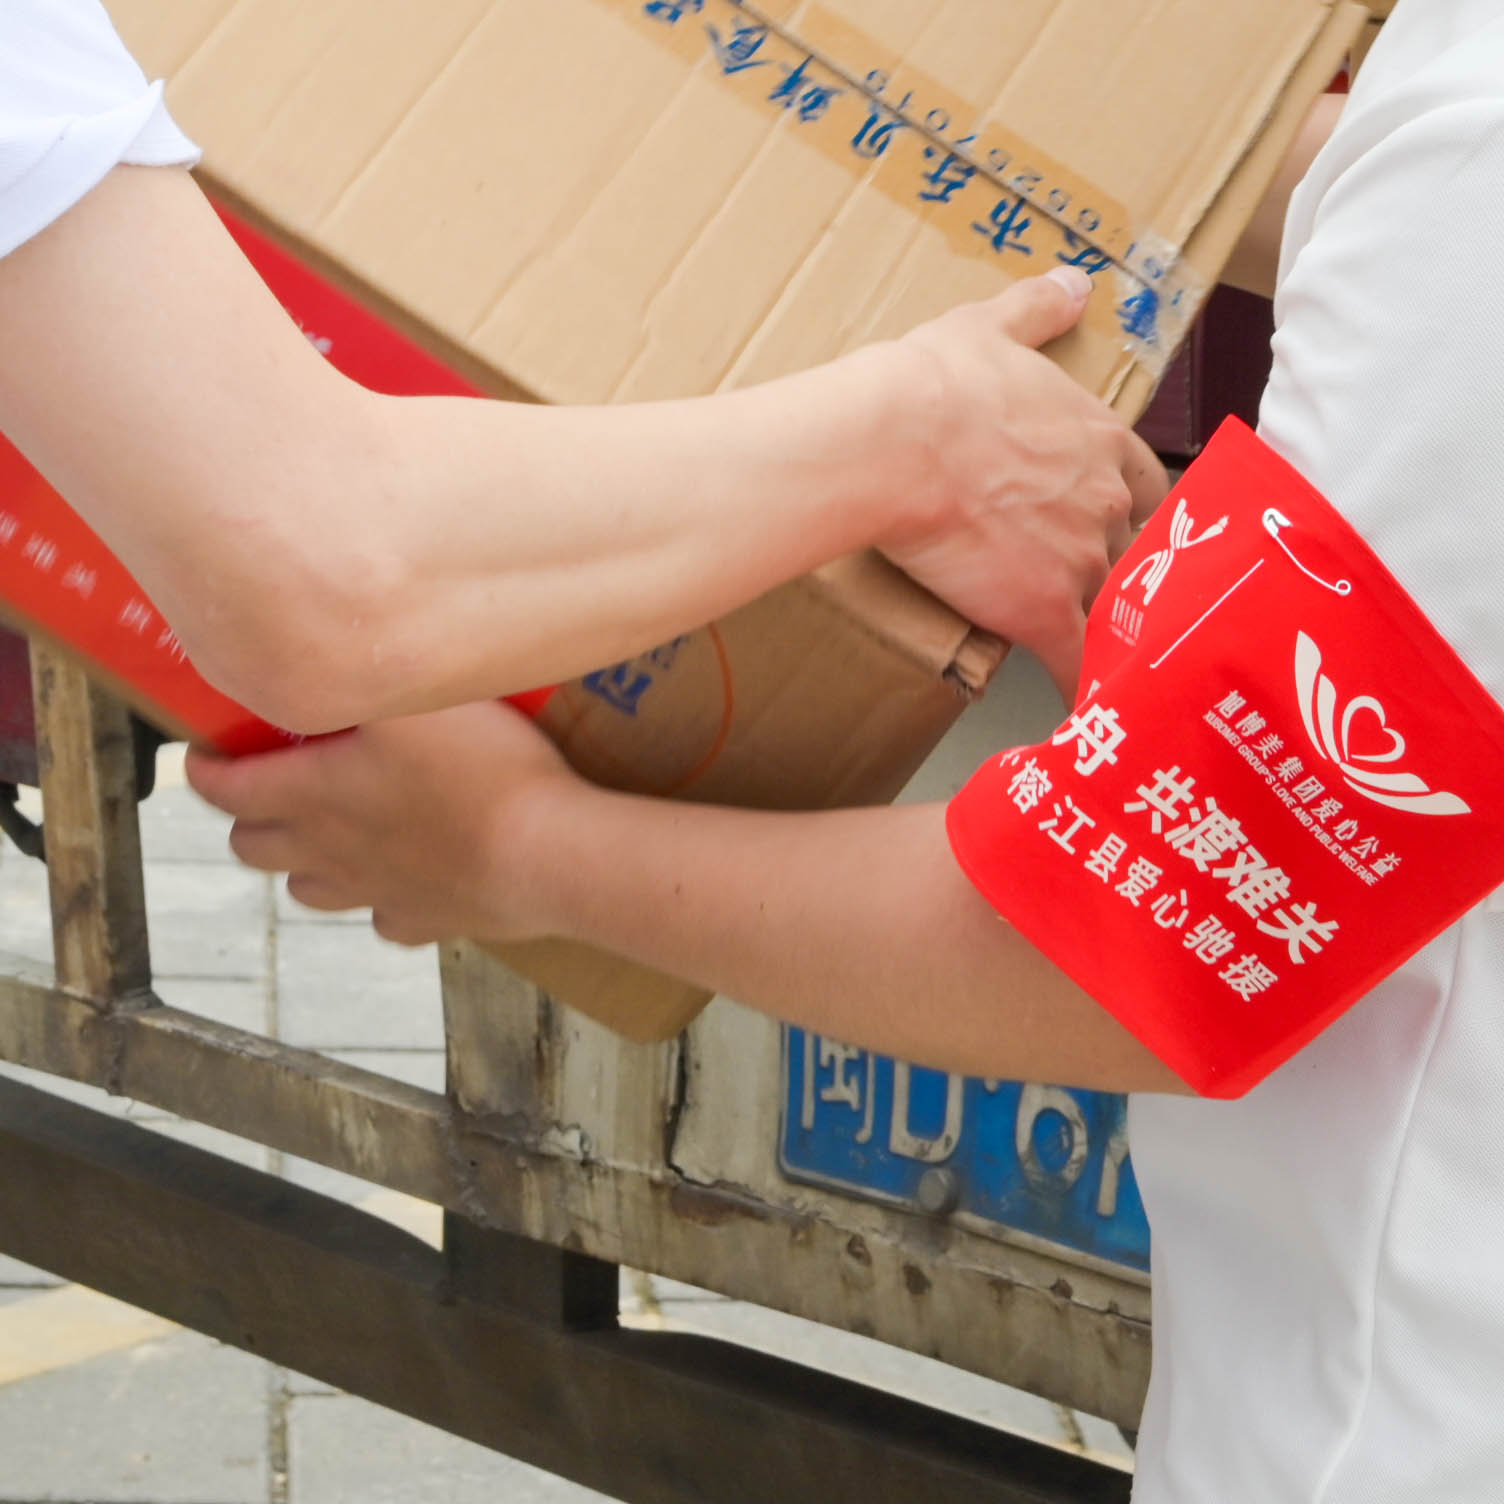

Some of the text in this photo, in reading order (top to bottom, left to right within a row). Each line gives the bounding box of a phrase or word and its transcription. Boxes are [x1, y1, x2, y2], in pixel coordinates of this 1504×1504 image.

[999, 750, 1278, 1001] 榕江县爱心驰援
[1052, 682, 1340, 965] 舟 共渡难关
[1213, 689, 1402, 878] 旭博美集团爱心公益
[1272, 782, 1296, 809] LOVE
[1292, 806, 1314, 832] AND
[1309, 824, 1342, 856] PUBLIC
[1338, 848, 1381, 887] WELFARE
